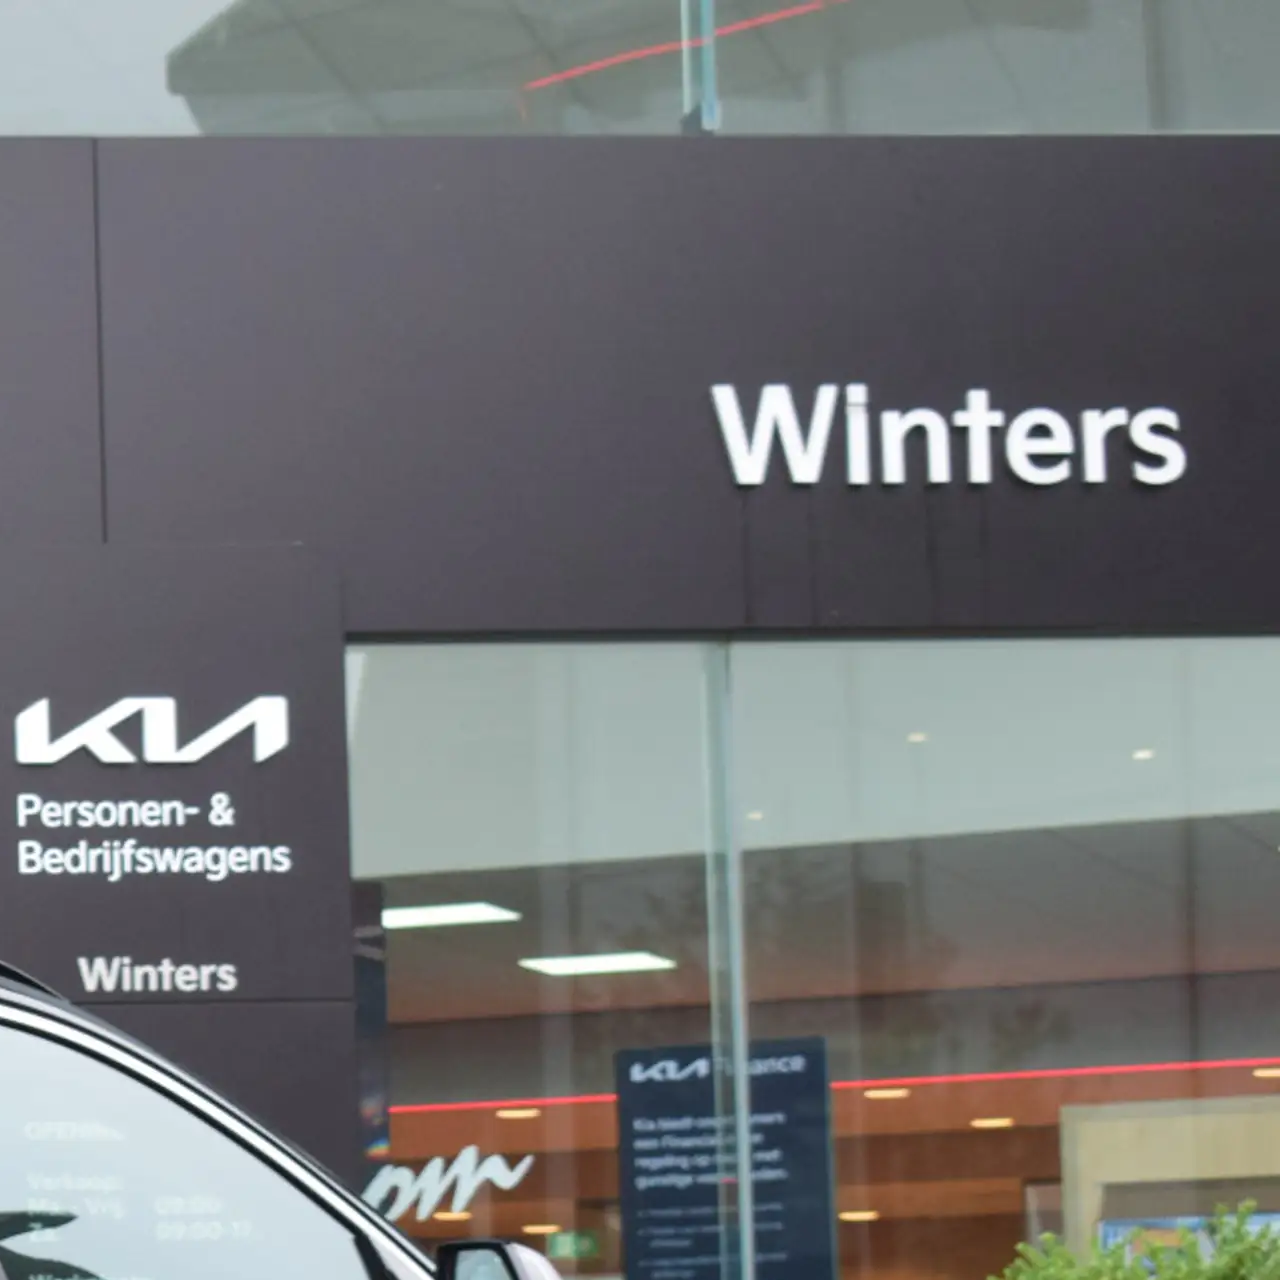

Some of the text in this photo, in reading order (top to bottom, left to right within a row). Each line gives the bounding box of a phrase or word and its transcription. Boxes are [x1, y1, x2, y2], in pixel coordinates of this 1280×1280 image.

[711, 383, 1187, 486] Winters
[15, 695, 289, 764] KIA
[16, 792, 236, 827] Personen- &
[17, 838, 293, 882] Bedrijfswagens
[77, 956, 238, 993] Winters
[629, 1057, 711, 1082] KIA
